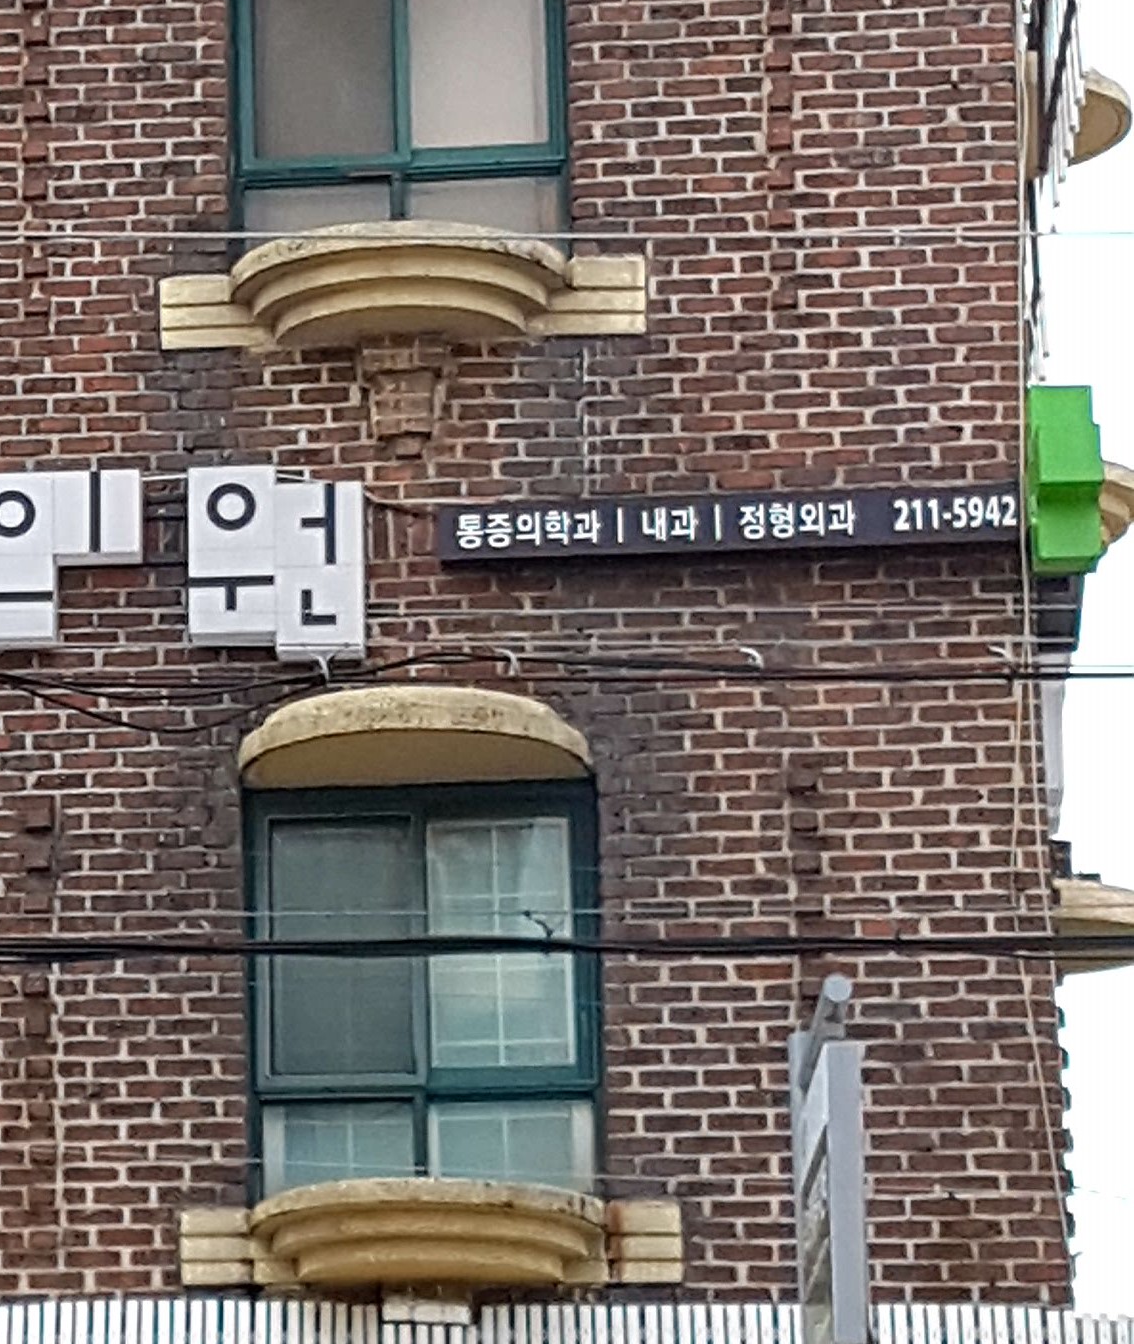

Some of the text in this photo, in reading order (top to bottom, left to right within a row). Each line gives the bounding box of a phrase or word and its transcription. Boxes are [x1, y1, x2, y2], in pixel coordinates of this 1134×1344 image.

[456, 495, 1017, 549] 통증의학과 내과 정형외과 211-5942
